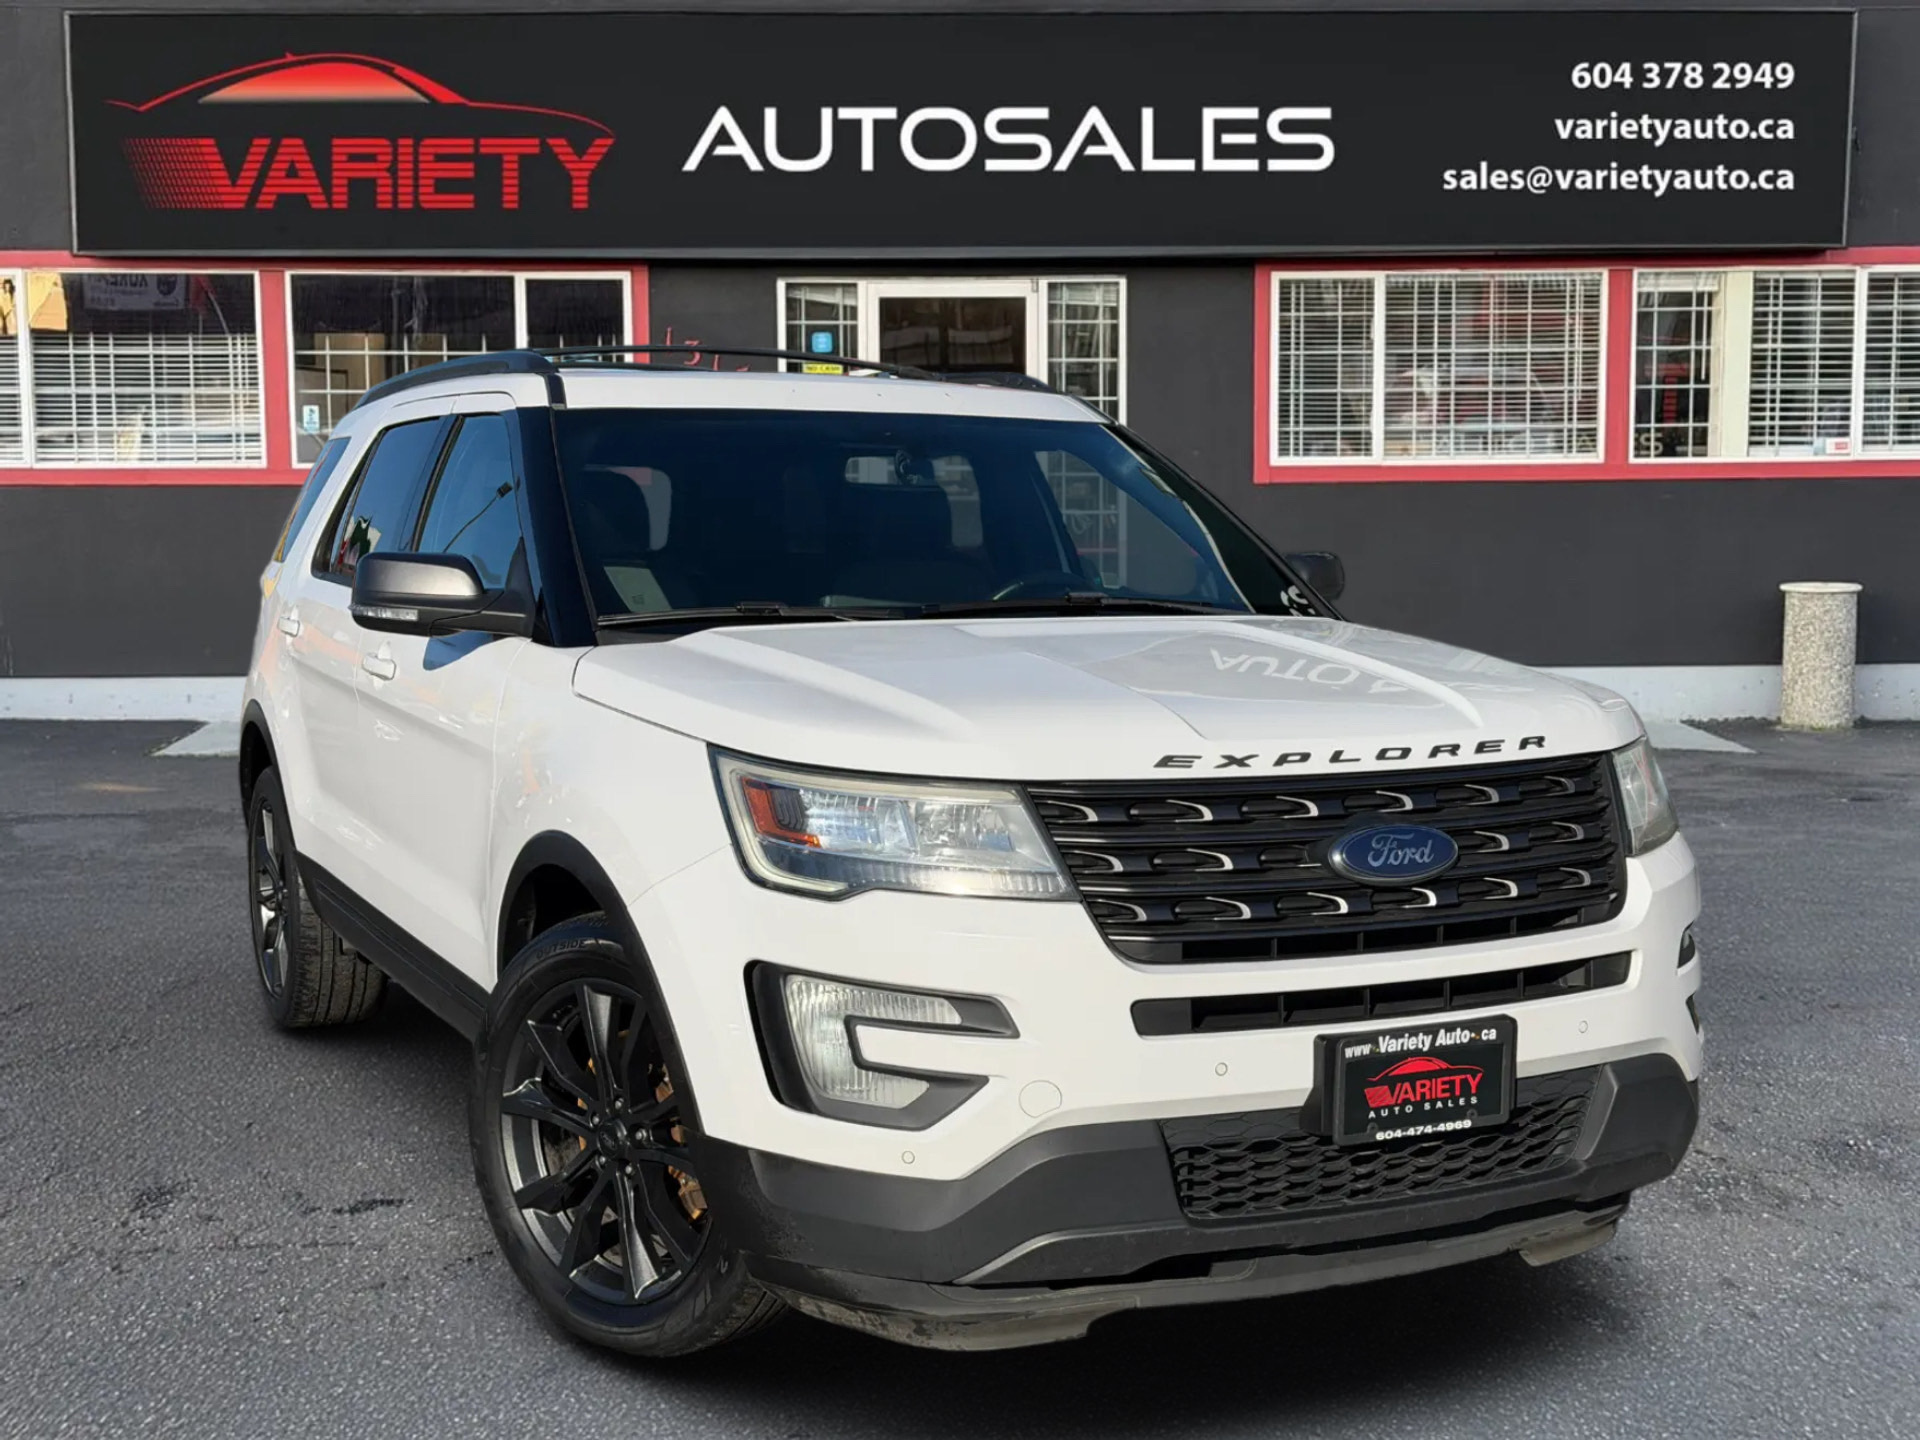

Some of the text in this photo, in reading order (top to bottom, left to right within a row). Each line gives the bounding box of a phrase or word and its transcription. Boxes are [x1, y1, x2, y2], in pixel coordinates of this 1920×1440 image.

[1571, 62, 1795, 89] 604 378 2949
[1555, 111, 1795, 147] varietyauto.ca
[124, 137, 615, 209] VARIETY
[1443, 161, 1795, 198] sales@varietyauto.ca
[1153, 735, 1546, 769] EXPLORER
[1367, 833, 1435, 867] Ford
[1378, 1032, 1433, 1052] Variety
[1364, 1072, 1484, 1108] VARIETY
[1368, 1096, 1478, 1119] AUTO SALES
[1376, 1119, 1472, 1140] 604-474-4969
